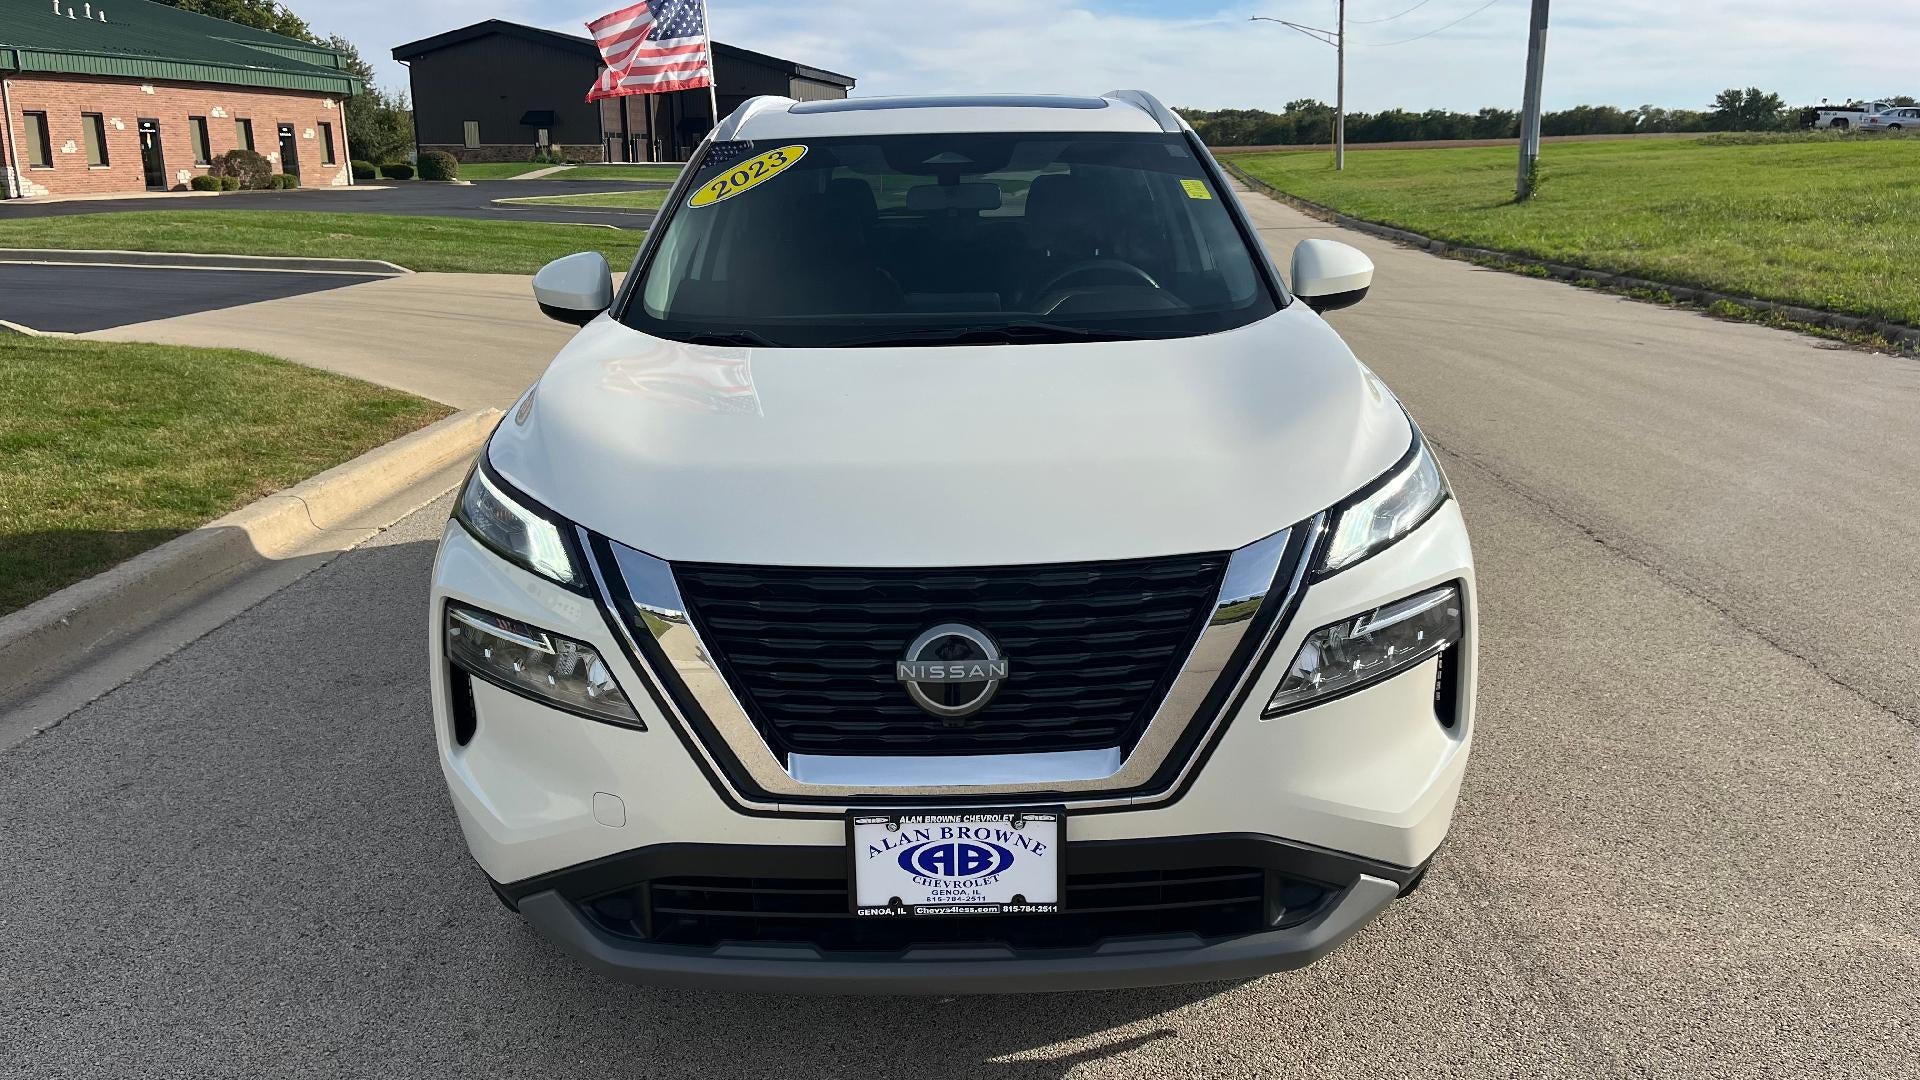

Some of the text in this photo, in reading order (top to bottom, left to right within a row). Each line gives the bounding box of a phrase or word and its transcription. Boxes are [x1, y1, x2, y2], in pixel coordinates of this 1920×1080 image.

[711, 151, 788, 199] 2023
[900, 662, 1005, 678] NISSAN
[900, 815, 922, 823] ALAN
[925, 815, 961, 823] BROWNE
[963, 814, 1014, 822] CHEVROLET
[868, 826, 1047, 859] ALAN BROWNE
[912, 874, 1000, 888] CHEVROLET
[857, 907, 907, 916] GENOA, IL
[1002, 905, 1058, 913] 815-784-2511
